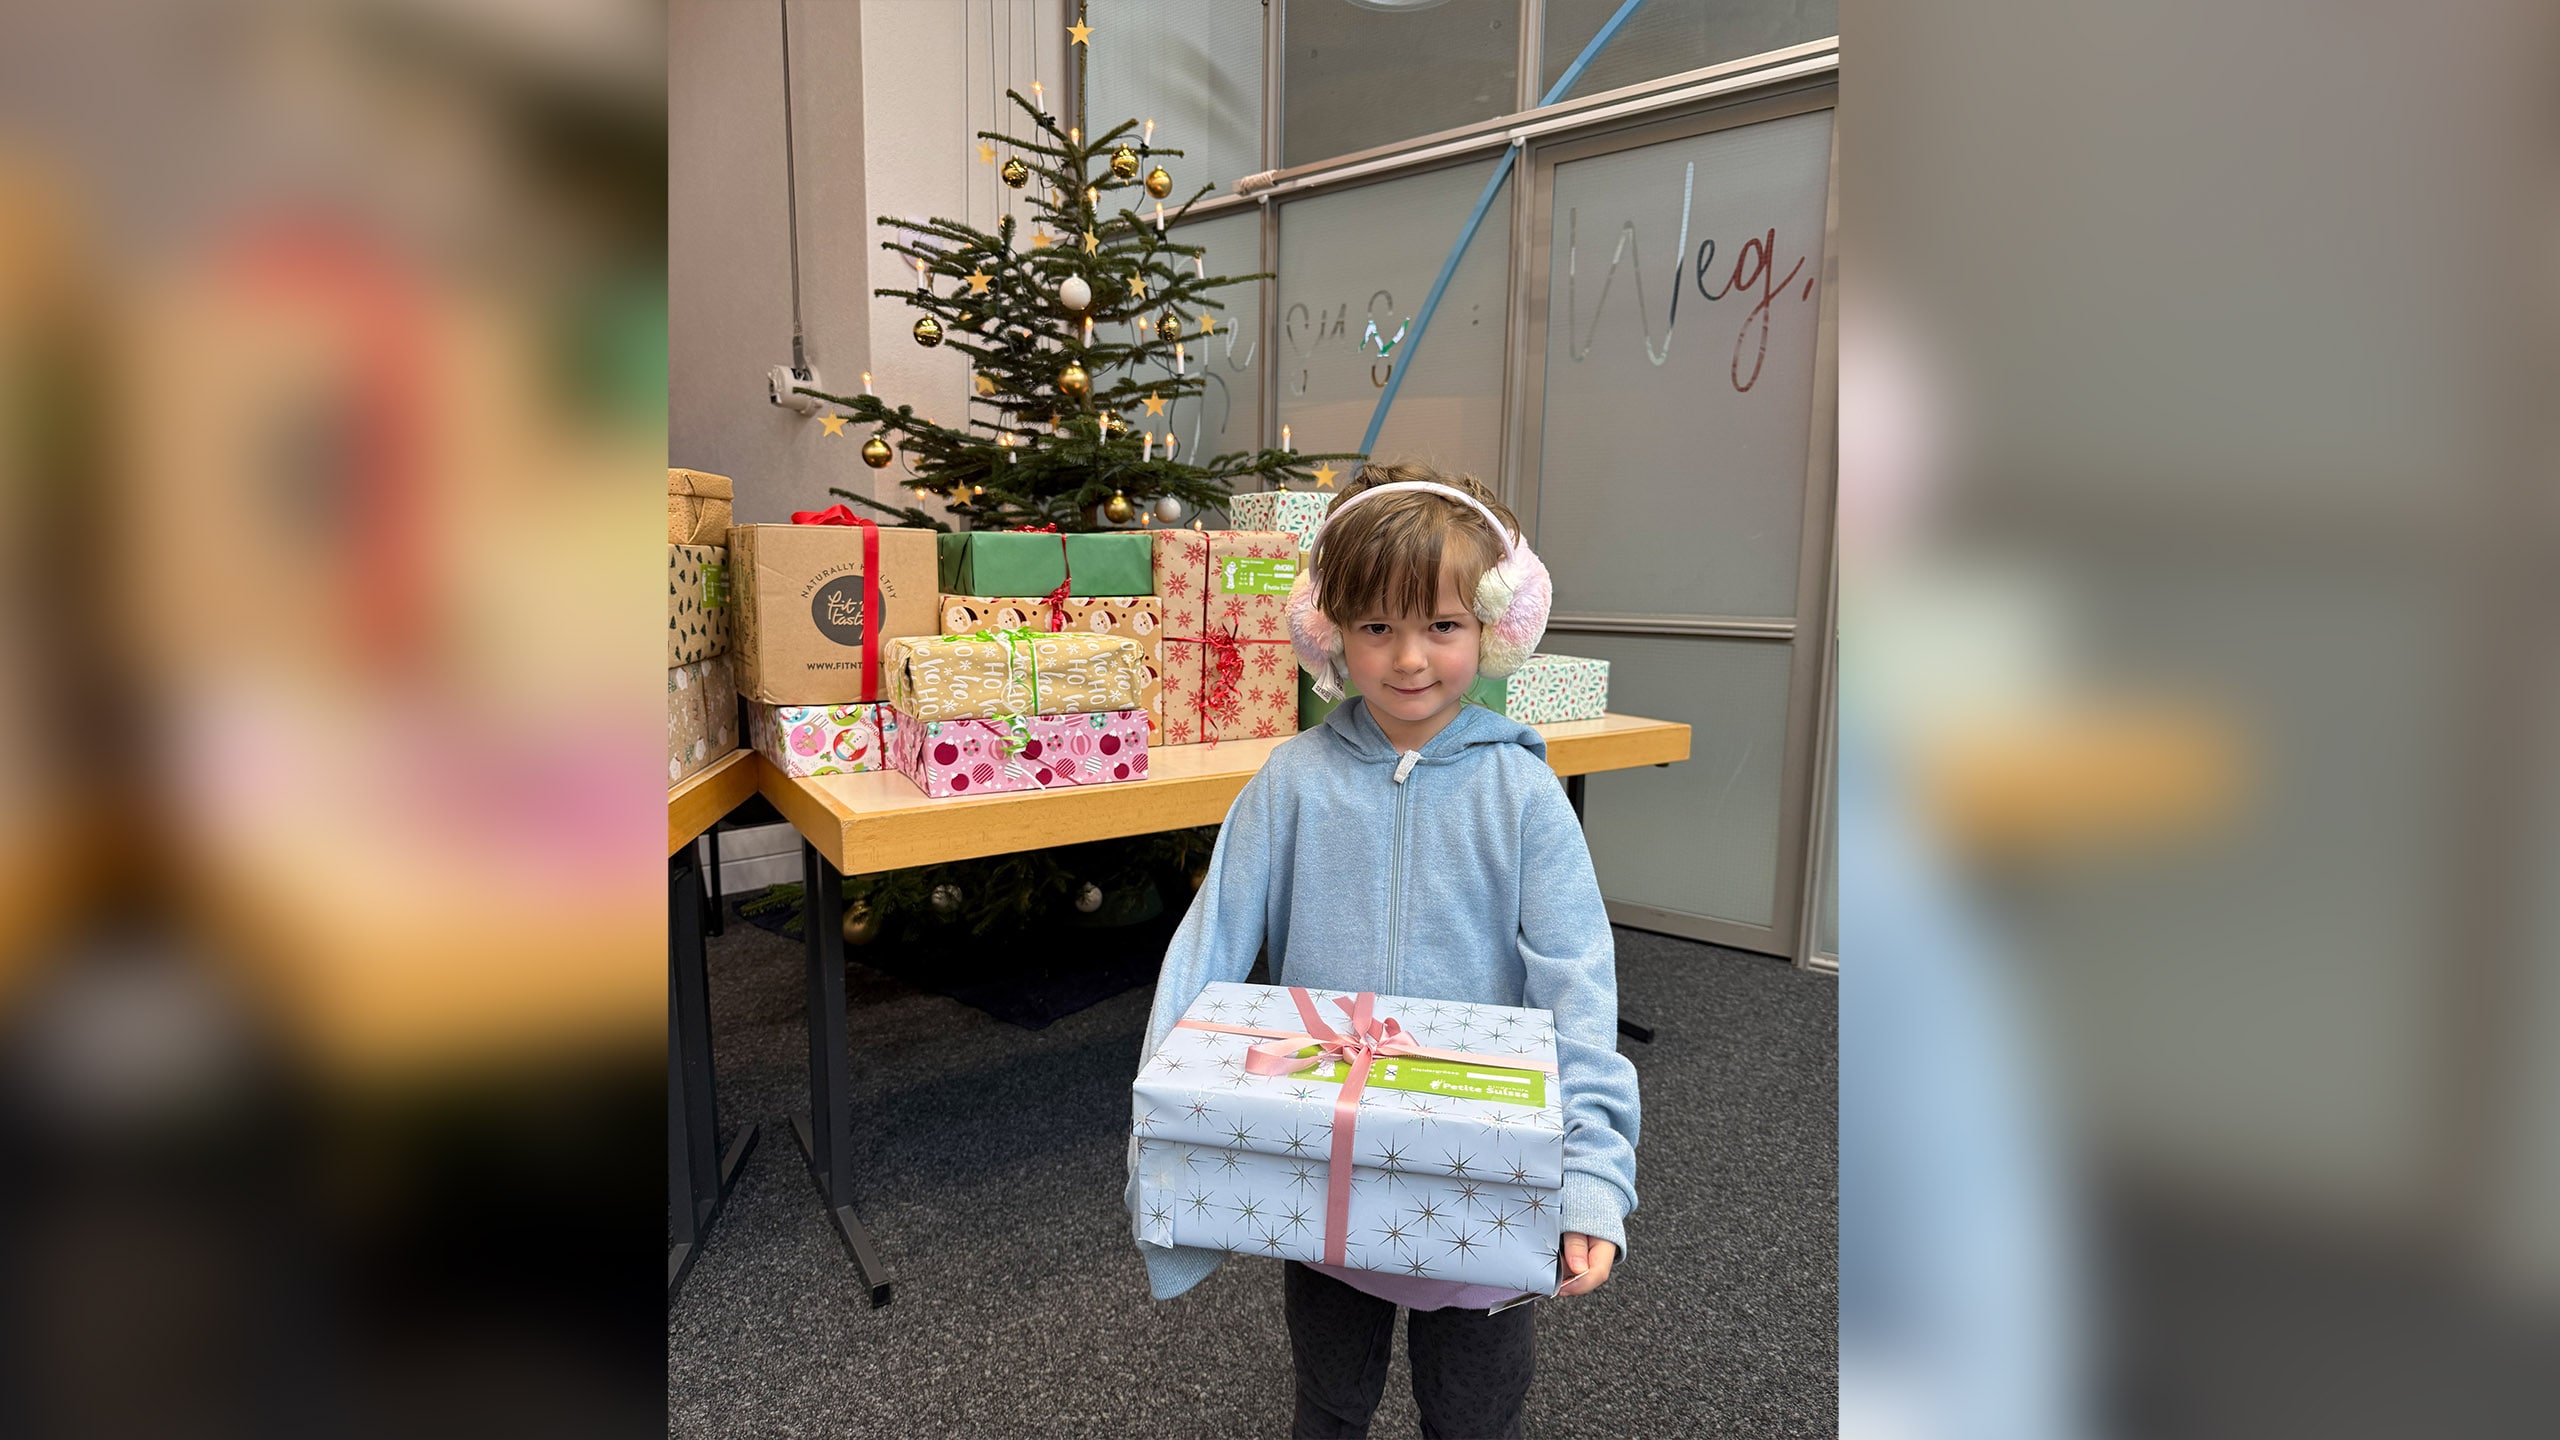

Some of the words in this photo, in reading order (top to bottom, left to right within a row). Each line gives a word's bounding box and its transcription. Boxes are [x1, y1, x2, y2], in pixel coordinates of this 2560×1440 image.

[1569, 161, 1815, 393] Weg,
[801, 562, 855, 598] NATURALLY
[860, 565, 897, 599] HLTHY
[828, 590, 865, 620] fit'
[832, 607, 865, 640] tast
[807, 661, 885, 670] WWW.FITNTY
[982, 662, 1006, 690] HO
[1067, 659, 1088, 686] HO
[918, 687, 940, 716] HO
[1087, 680, 1107, 705] HO
[1442, 1082, 1482, 1093] Petite
